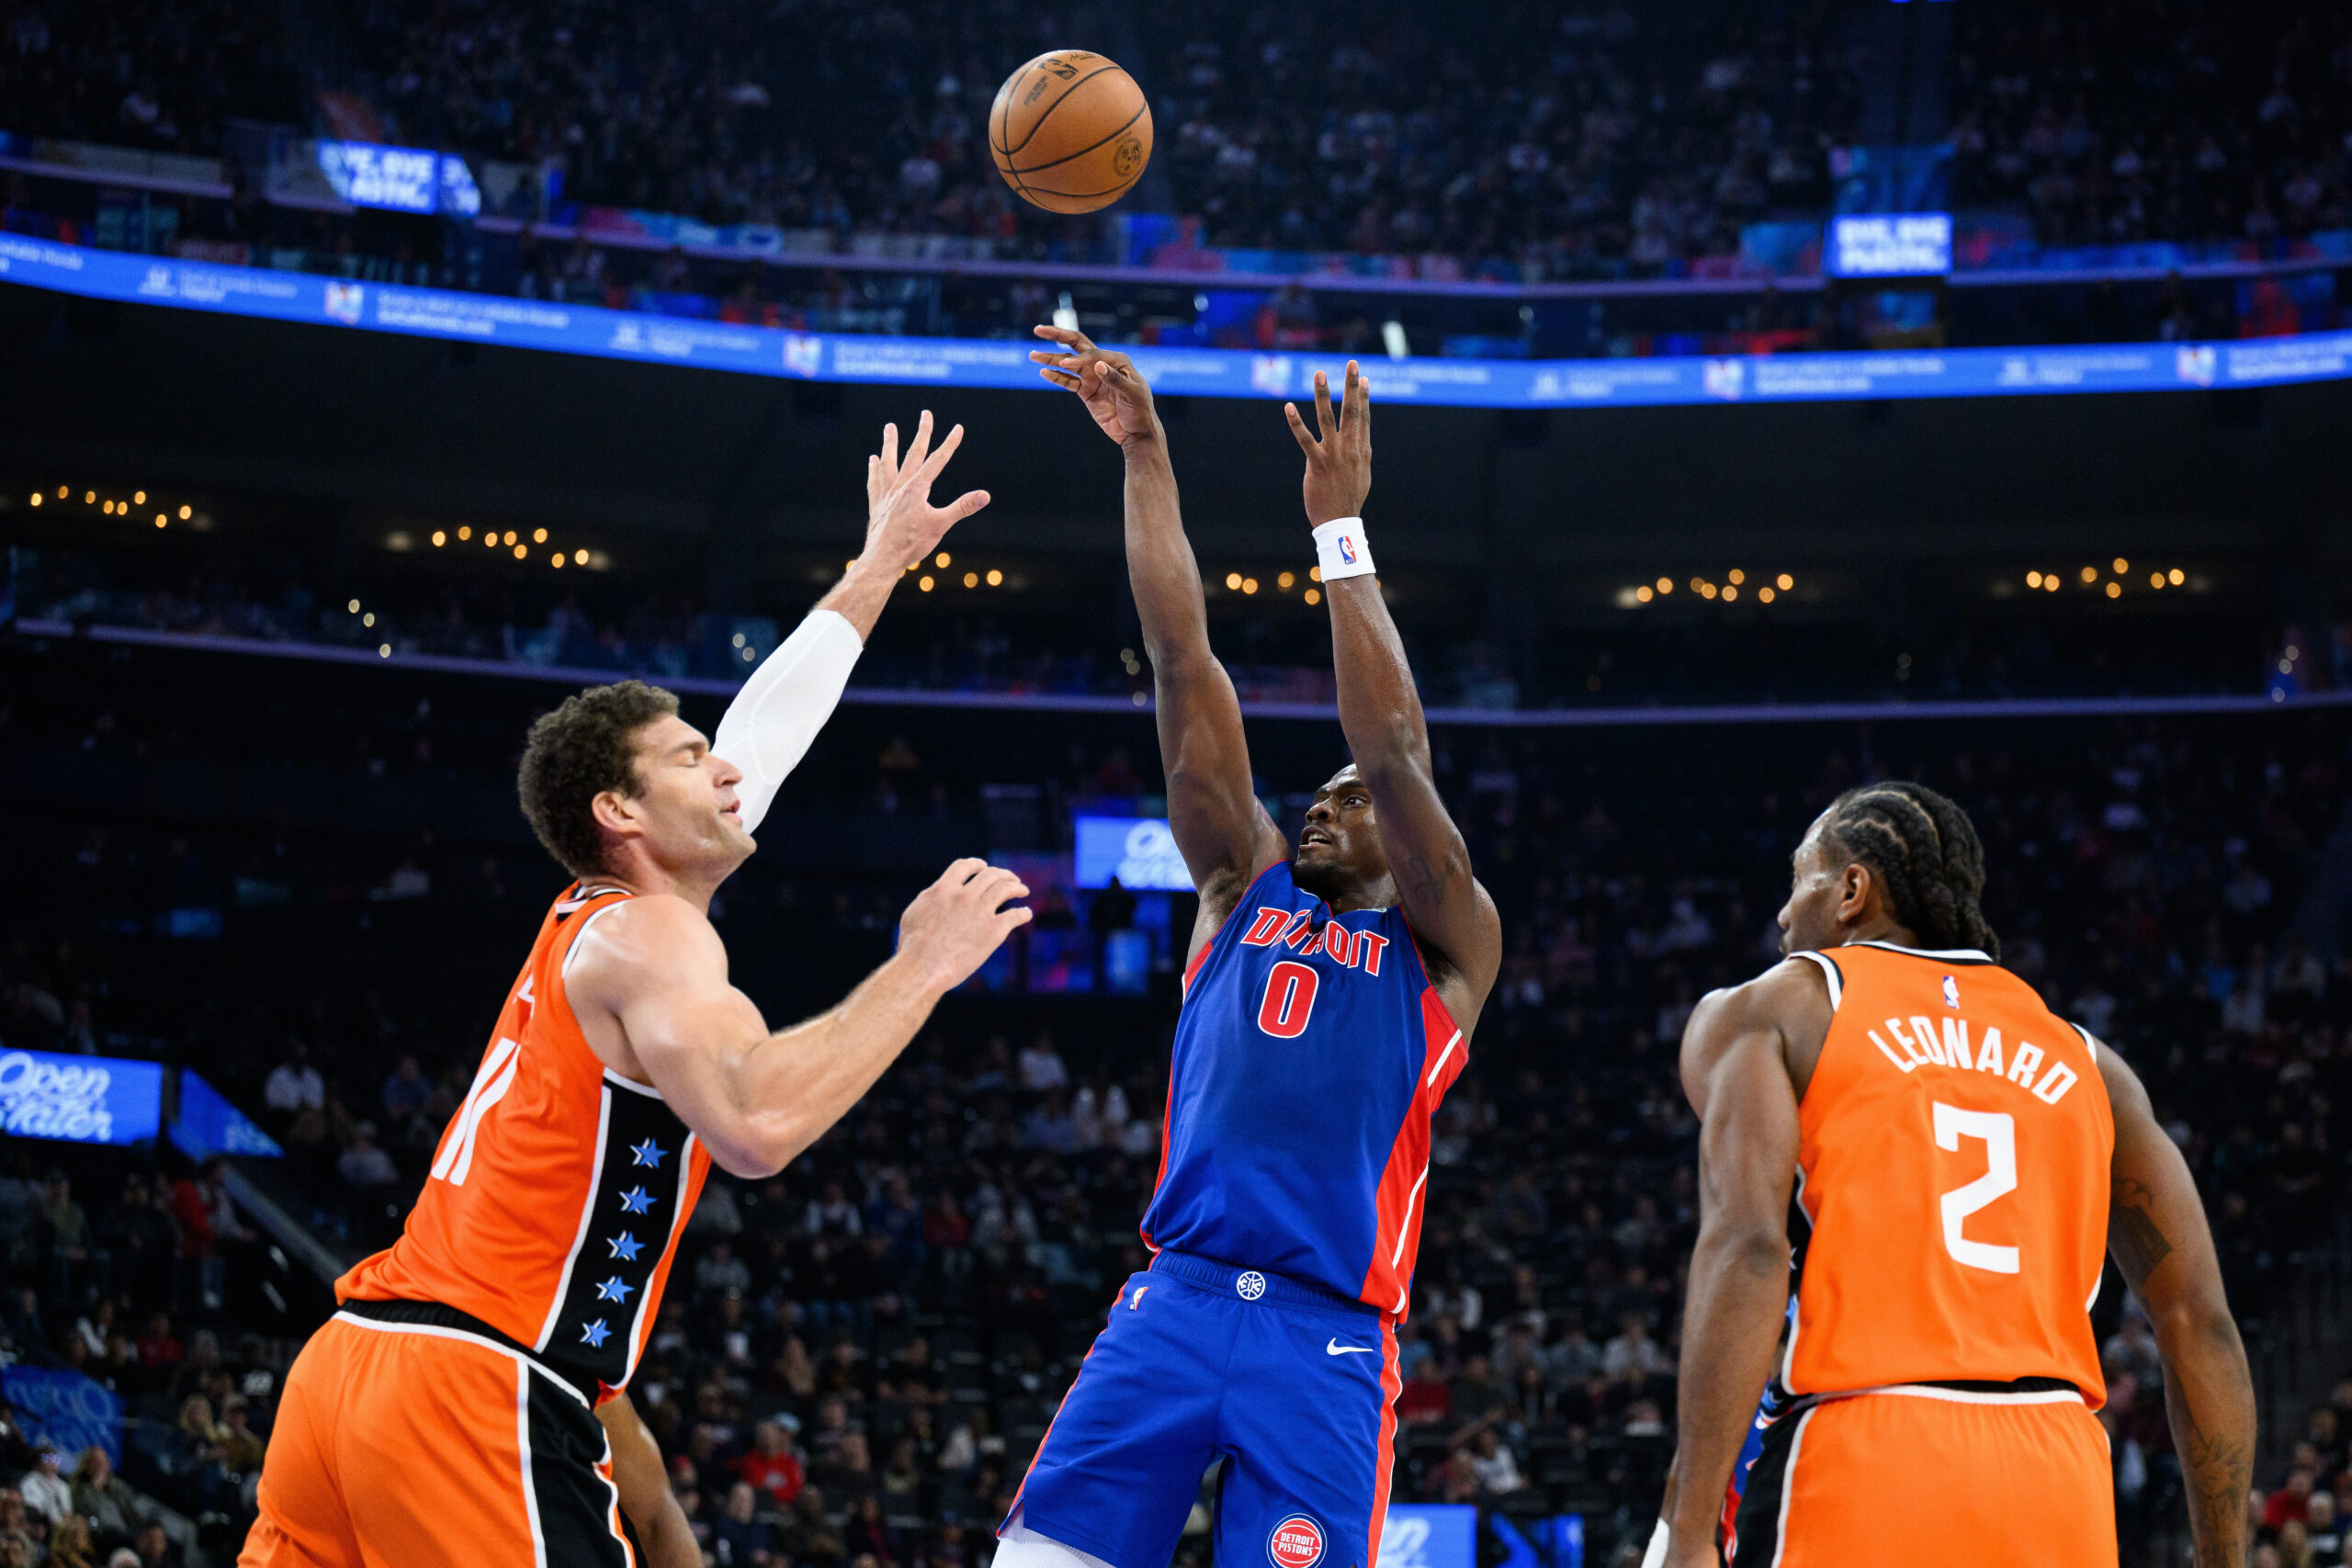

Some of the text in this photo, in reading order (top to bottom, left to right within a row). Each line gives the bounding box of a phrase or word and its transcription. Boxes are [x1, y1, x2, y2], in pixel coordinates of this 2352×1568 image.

[1257, 960, 1319, 1039] 0
[0, 1051, 110, 1102] Open
[1867, 1016, 2078, 1105] LEONARD
[1932, 1100, 2020, 1274] 2
[1278, 1541, 1314, 1557] PISTONS
[1281, 1532, 1315, 1547] DETROIT
